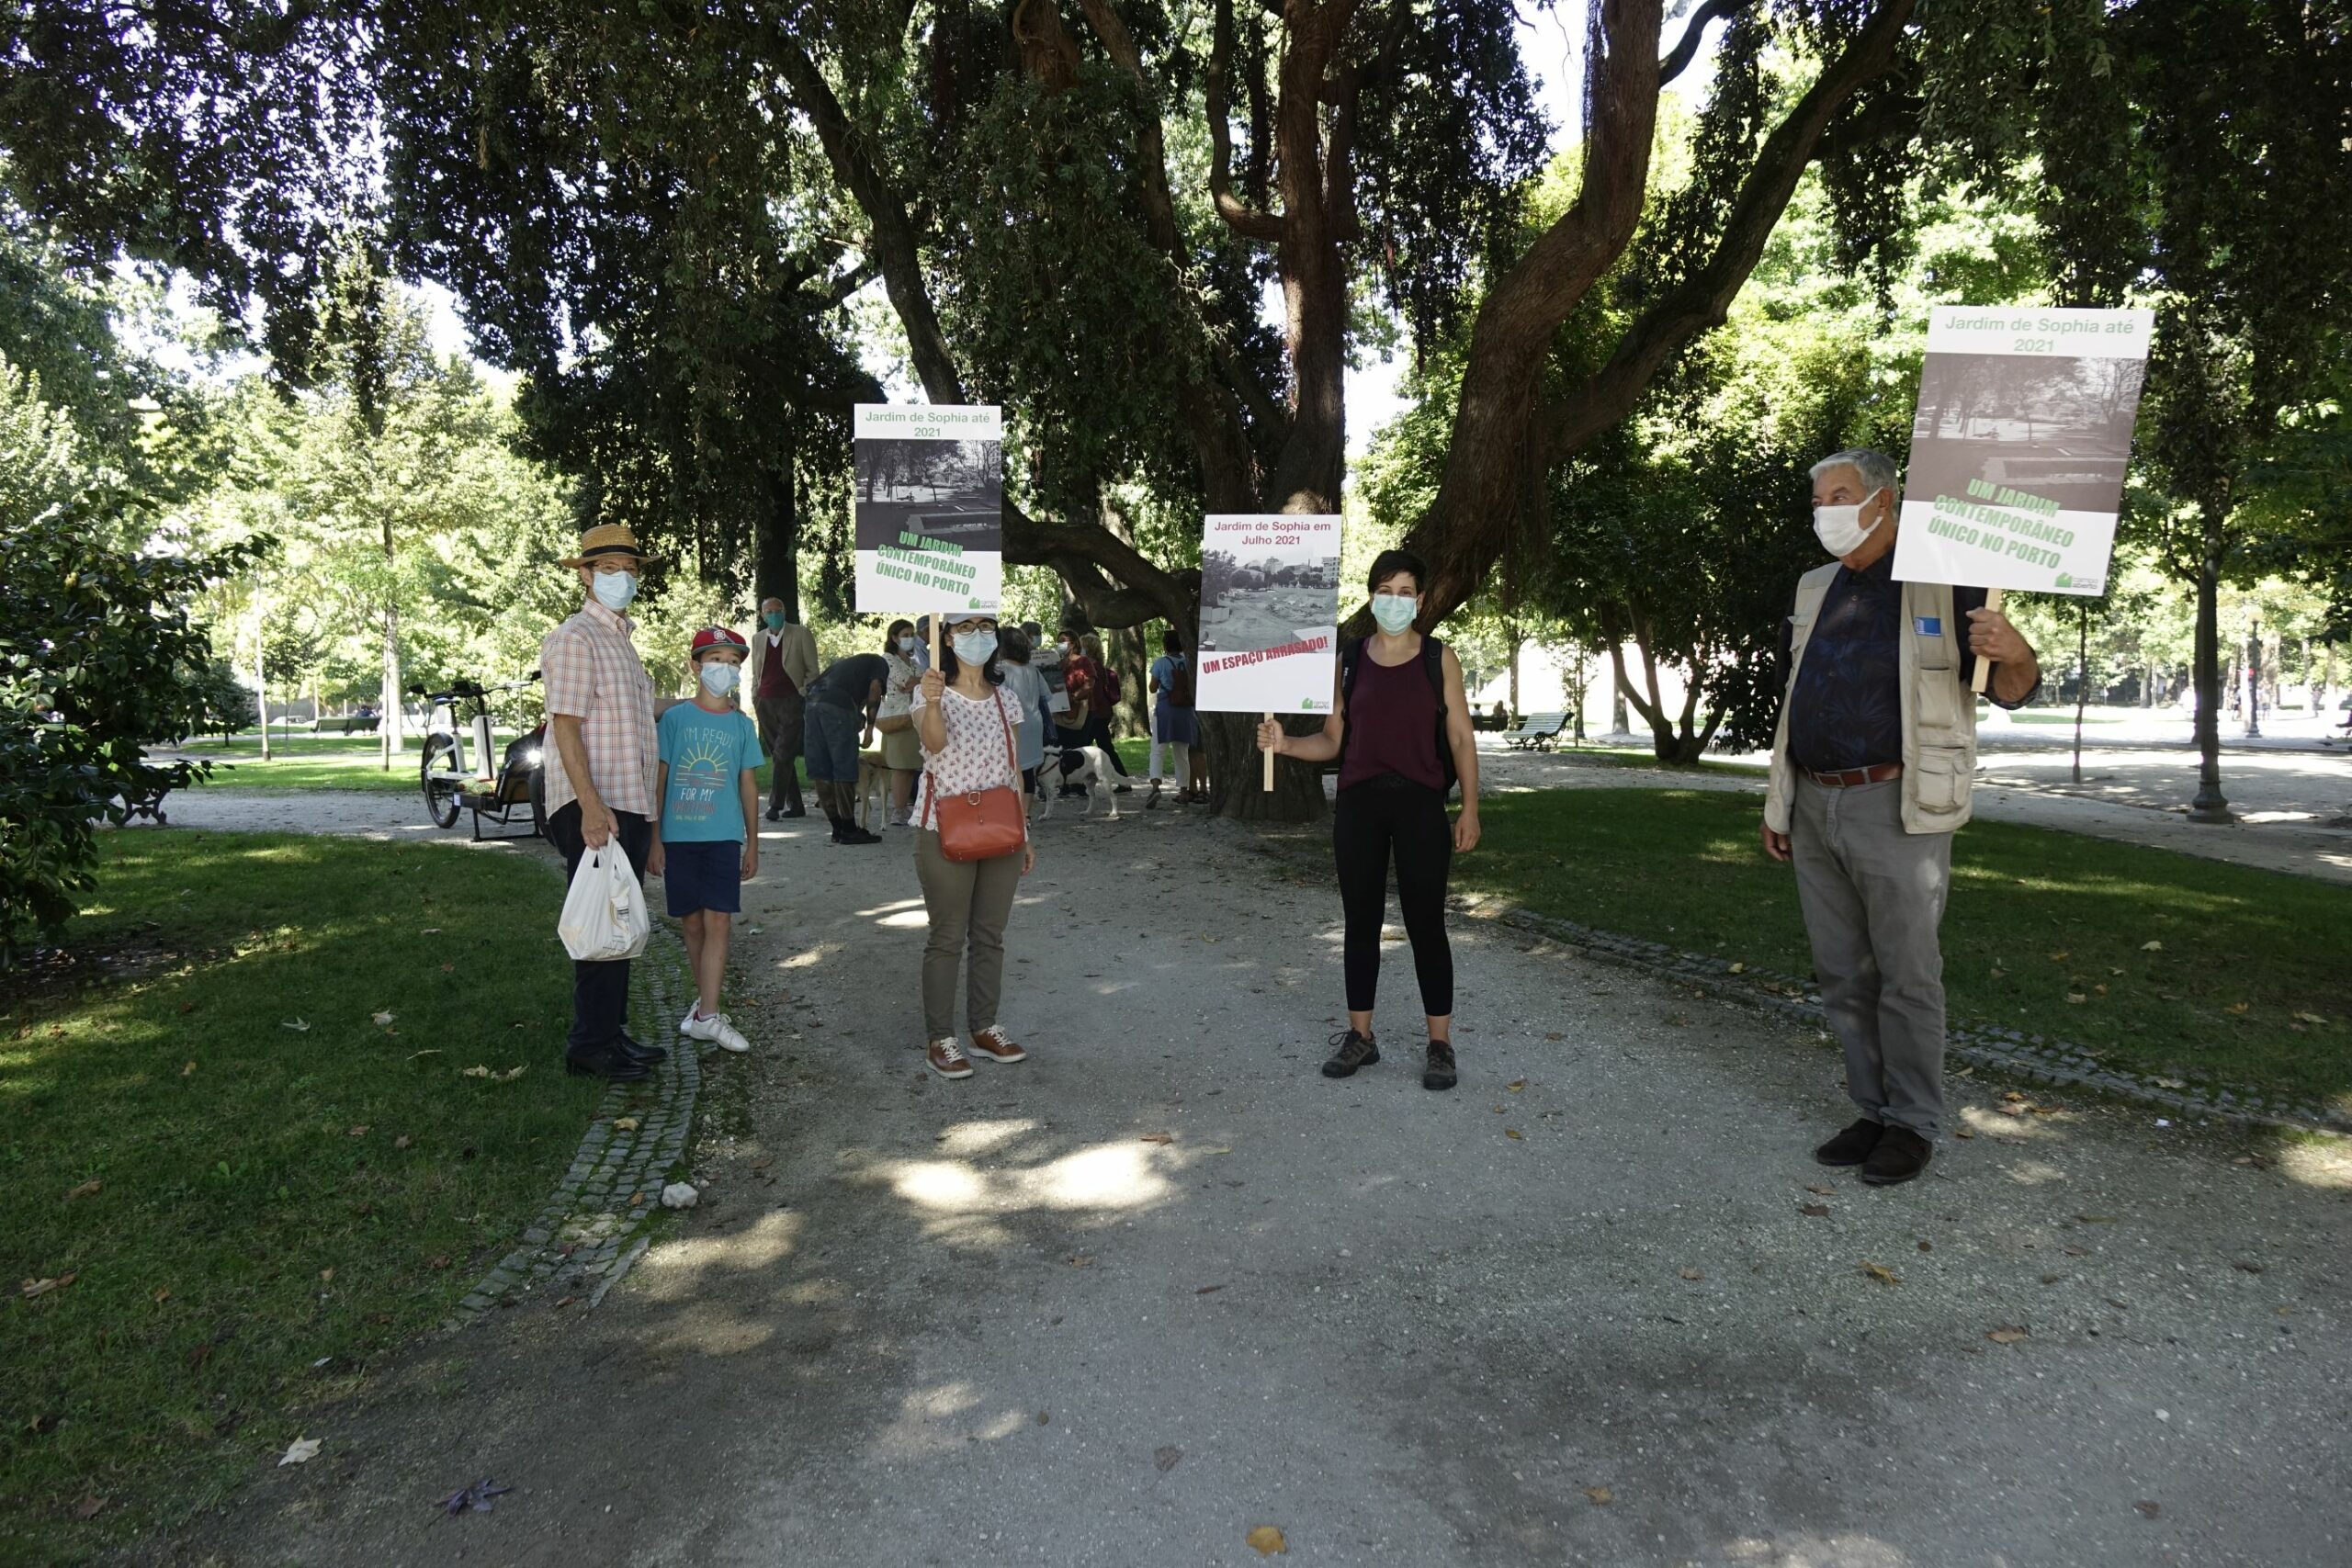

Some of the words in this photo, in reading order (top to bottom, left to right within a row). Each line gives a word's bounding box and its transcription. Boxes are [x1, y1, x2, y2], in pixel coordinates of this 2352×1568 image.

[1945, 317, 2004, 331] Jardim
[2010, 318, 2031, 331] de
[2038, 318, 2098, 335] Sophia
[2105, 319, 2134, 333] até
[2014, 339, 2054, 352] 2021
[865, 412, 906, 423] Jardim
[910, 412, 924, 423] de
[928, 412, 968, 425] Sophia
[972, 412, 989, 423] até
[914, 427, 941, 437] 2021
[1966, 479, 1993, 497] UM
[1996, 487, 2061, 517] JARDIM
[1215, 522, 1251, 531] Jardim
[1255, 522, 1269, 531] de
[1272, 522, 1310, 533] Sophia
[1314, 523, 1330, 531] em
[1934, 494, 2075, 547] CONTEMPORÂNEO
[899, 531, 917, 546] UM
[919, 536, 964, 557] JARDIM
[1242, 536, 1272, 545] Julho
[1275, 536, 1300, 545] 2021
[1928, 516, 1978, 546] ÚNICO
[1980, 532, 2002, 552] NO
[2006, 541, 2061, 569] PORTO
[877, 544, 977, 579] CONTEMPORÂNEO
[876, 561, 911, 581] ÚNICO
[915, 571, 930, 586] NO
[933, 575, 970, 595] PORTO
[1203, 660, 1220, 674] UM
[1223, 650, 1264, 670] ESPAÇO
[1266, 636, 1329, 660] ARRASADO!
[684, 728, 697, 742] I'M
[702, 728, 736, 748] READY
[681, 788, 696, 801] FOR
[700, 788, 715, 802] MY
